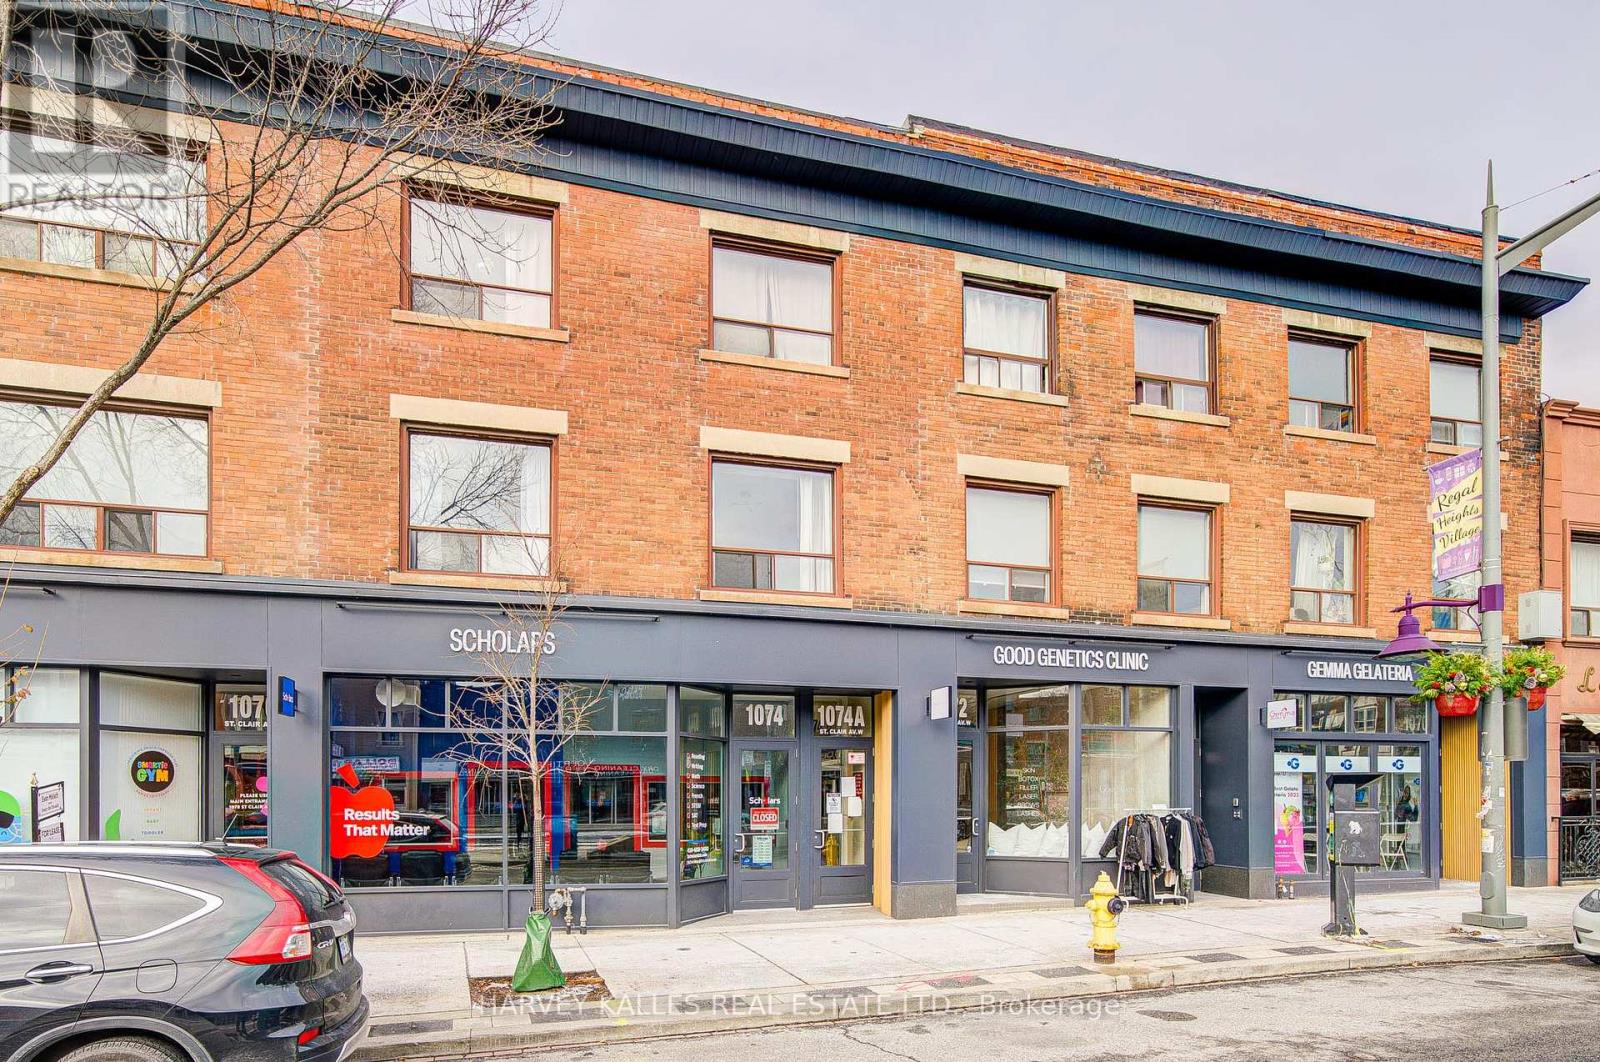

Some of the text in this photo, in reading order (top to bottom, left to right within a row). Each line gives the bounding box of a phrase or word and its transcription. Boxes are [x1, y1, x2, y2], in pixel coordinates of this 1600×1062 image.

[1436, 476, 1479, 512] Regal
[1435, 501, 1480, 530] Heights
[1438, 525, 1481, 549] Village
[449, 628, 556, 655] SCHOLARS
[993, 645, 1149, 671] GOOD GENETICS CLINIC
[1307, 661, 1414, 682] GEMMA GELATERIA
[1577, 664, 1600, 693] L
[229, 695, 268, 719] 107
[746, 703, 784, 726] 1074
[818, 705, 865, 727] 1074A
[958, 697, 968, 718] 2
[136, 768, 169, 783] GYM
[343, 808, 400, 821] Results
[753, 814, 777, 822] CLOSED
[343, 824, 431, 837] That Matter
